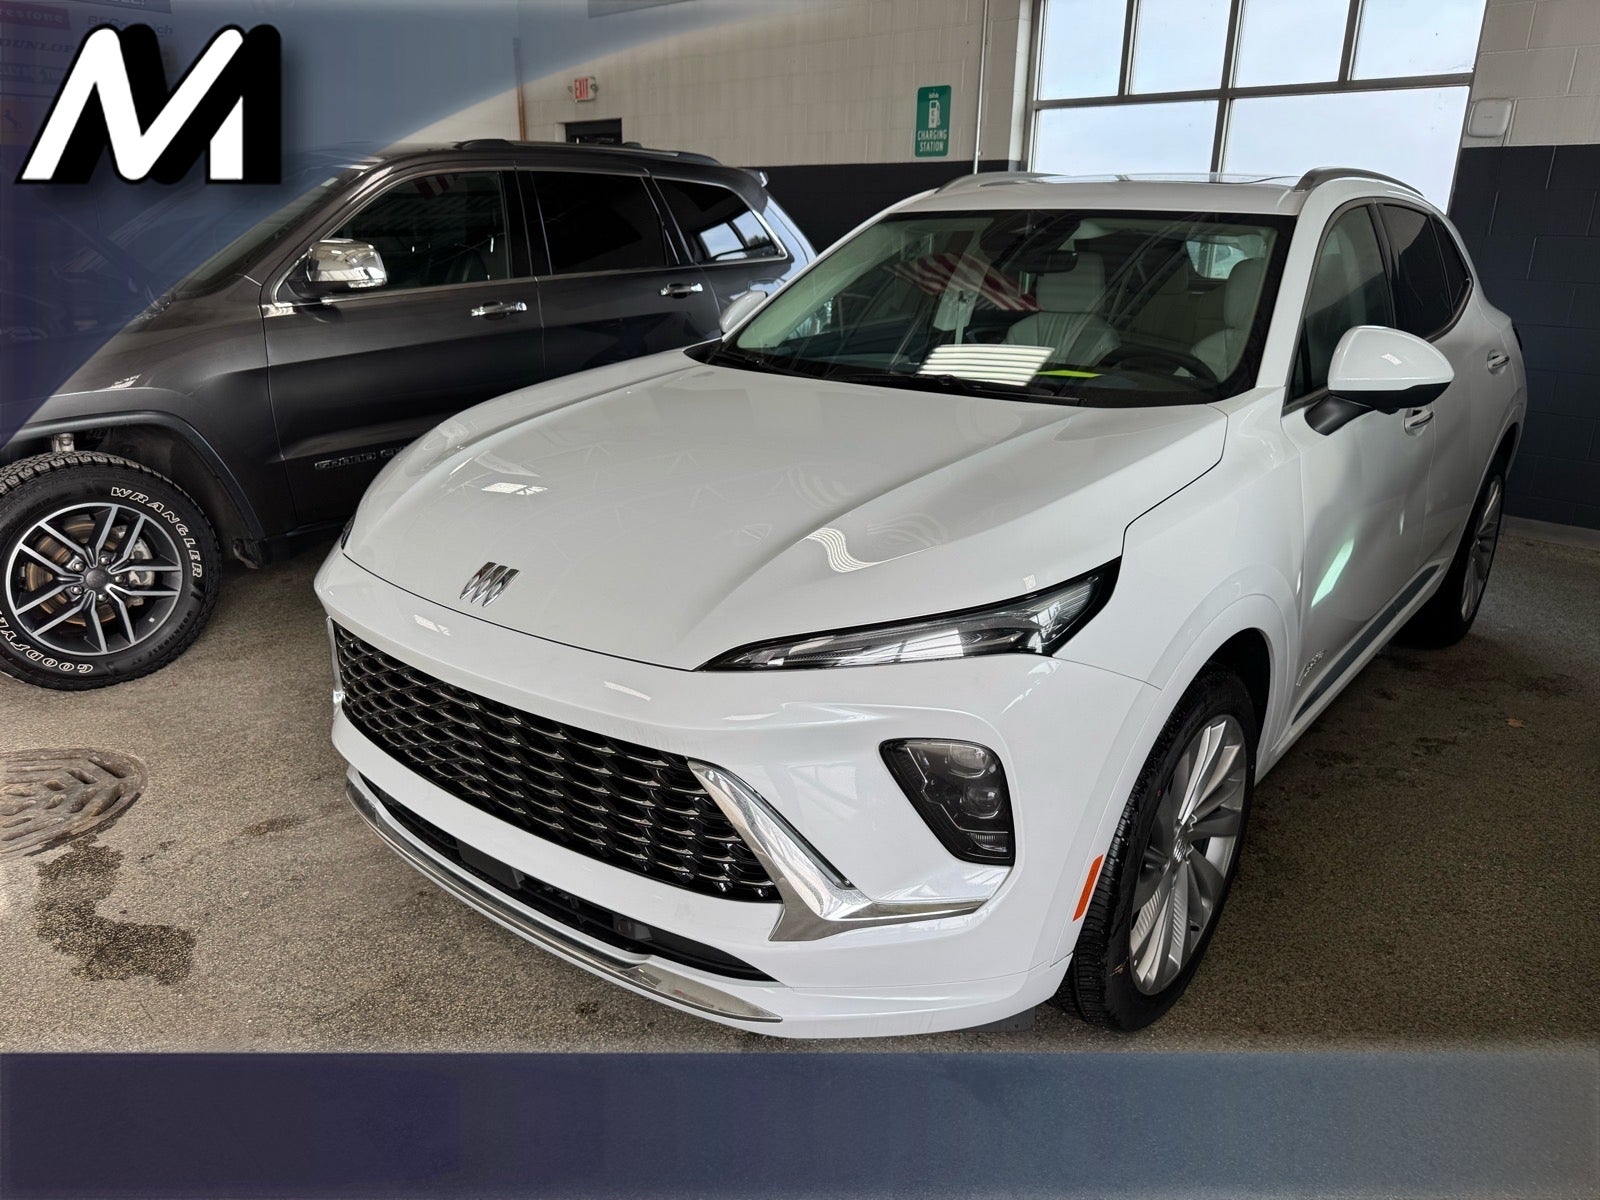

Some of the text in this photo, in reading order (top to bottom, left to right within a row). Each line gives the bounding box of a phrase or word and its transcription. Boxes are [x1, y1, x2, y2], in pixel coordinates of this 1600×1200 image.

[574, 78, 589, 99] EXIT
[918, 130, 947, 141] CHARGING
[919, 141, 944, 152] STATION
[110, 486, 203, 578] WRANGLER
